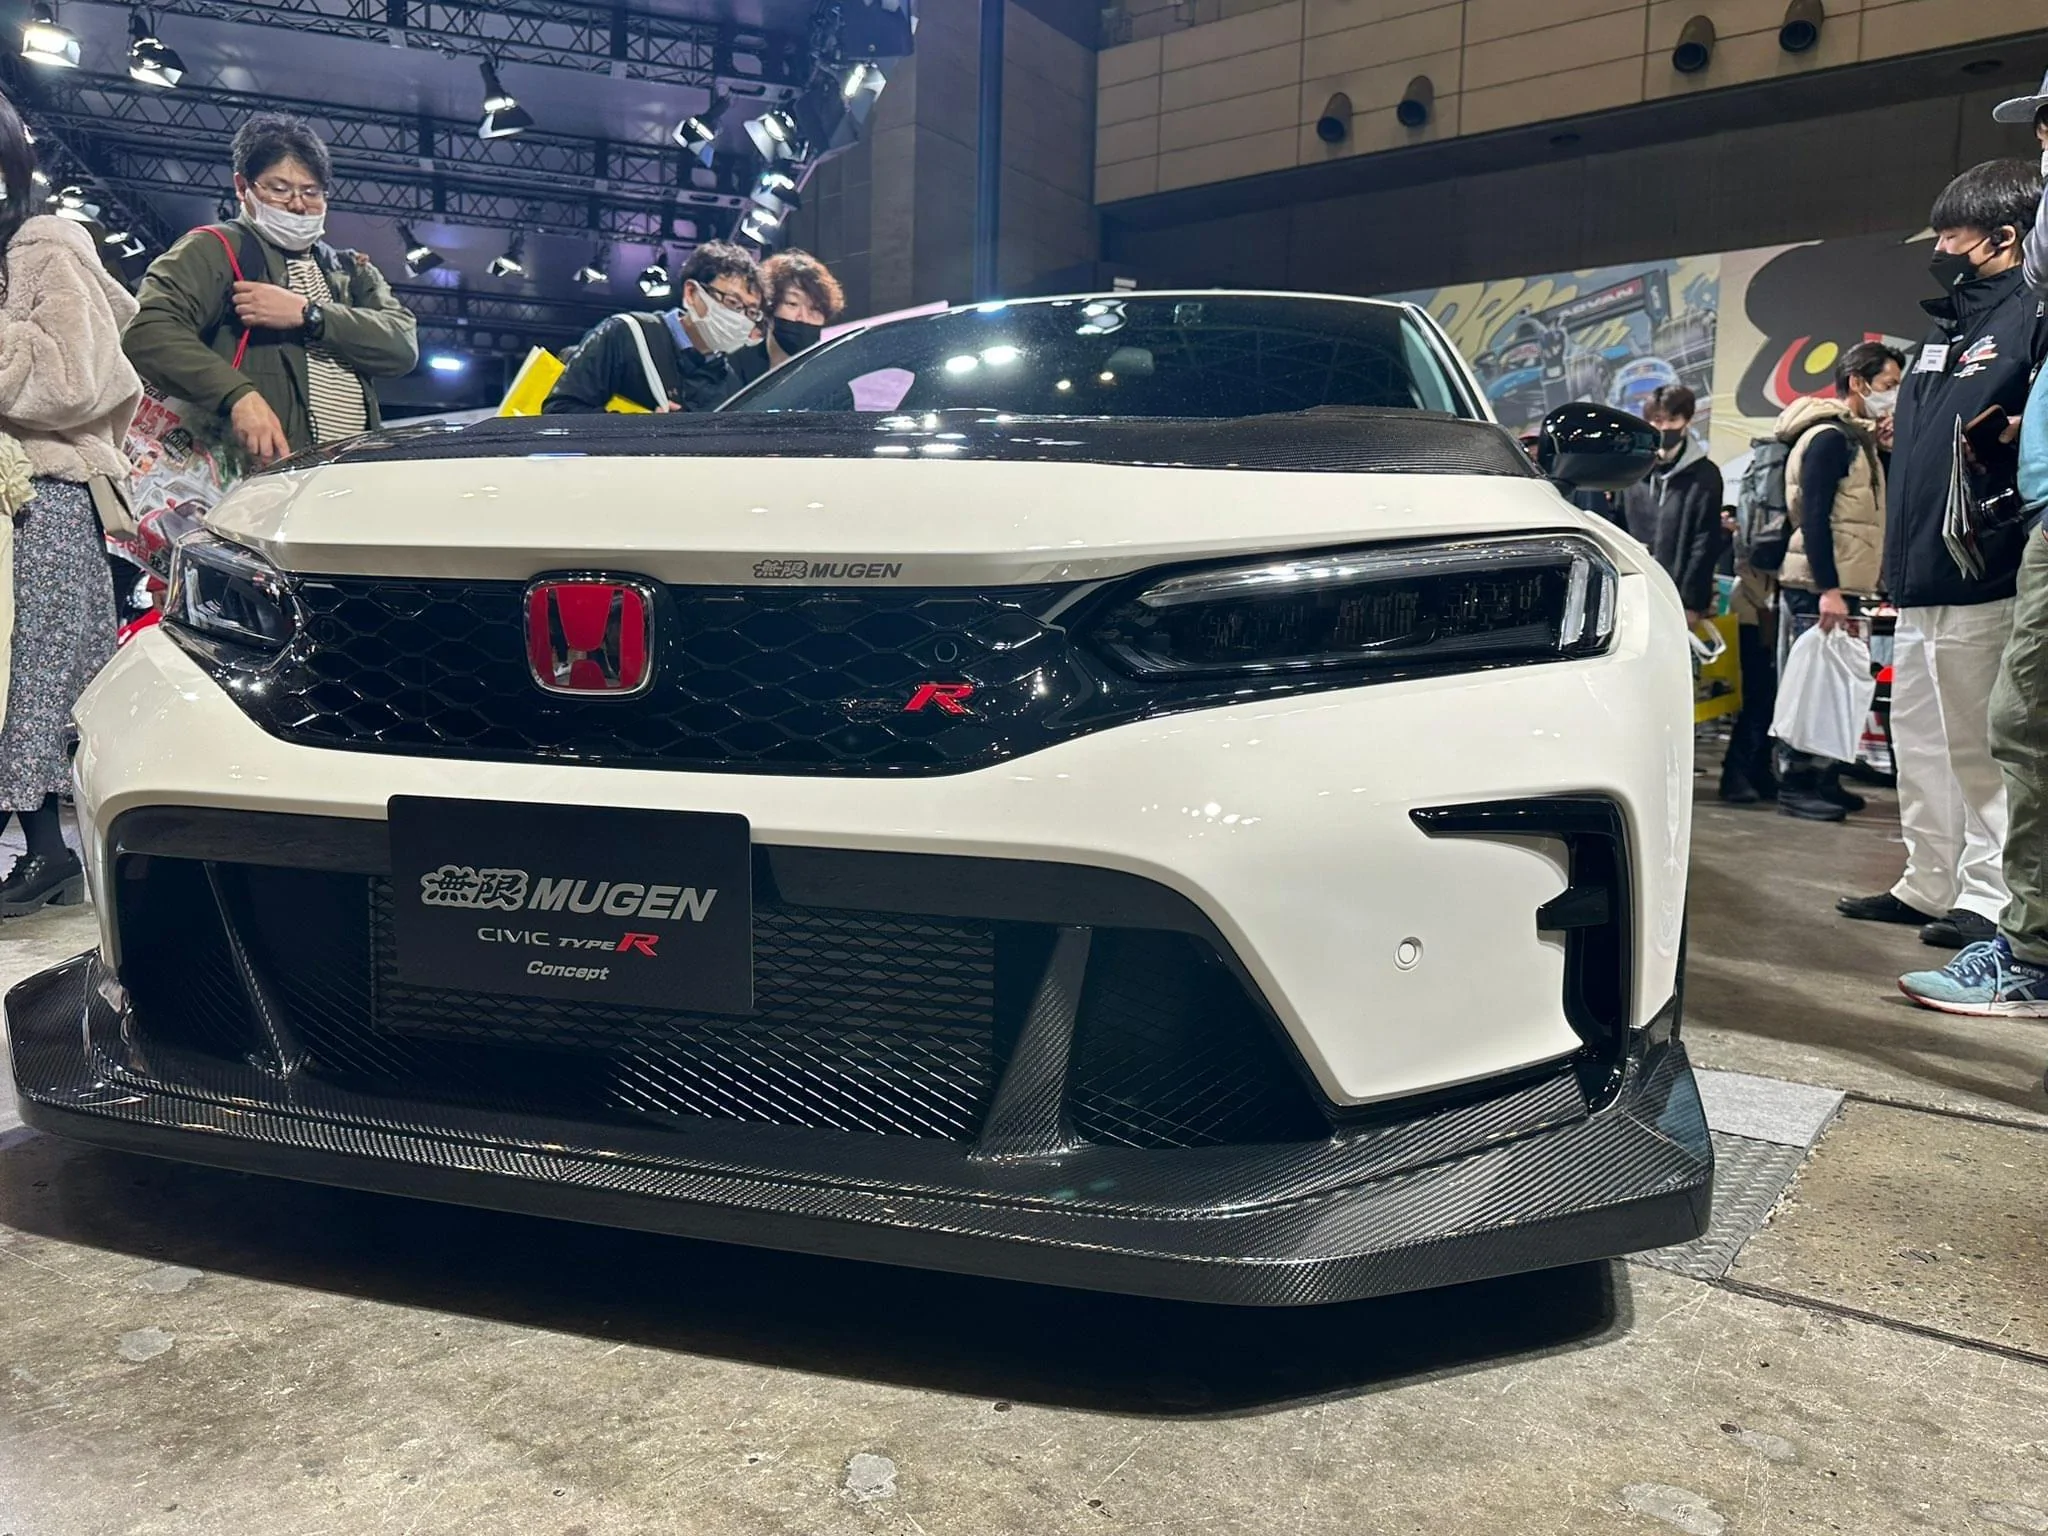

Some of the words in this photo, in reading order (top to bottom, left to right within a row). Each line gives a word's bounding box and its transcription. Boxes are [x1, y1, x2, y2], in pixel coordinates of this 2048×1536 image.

[753, 559, 808, 579] 無限
[809, 563, 903, 578] MUGEN
[420, 865, 529, 911] 無限
[527, 877, 718, 922] MUGEN
[477, 927, 550, 946] CIVIC
[526, 960, 611, 981] Concept
